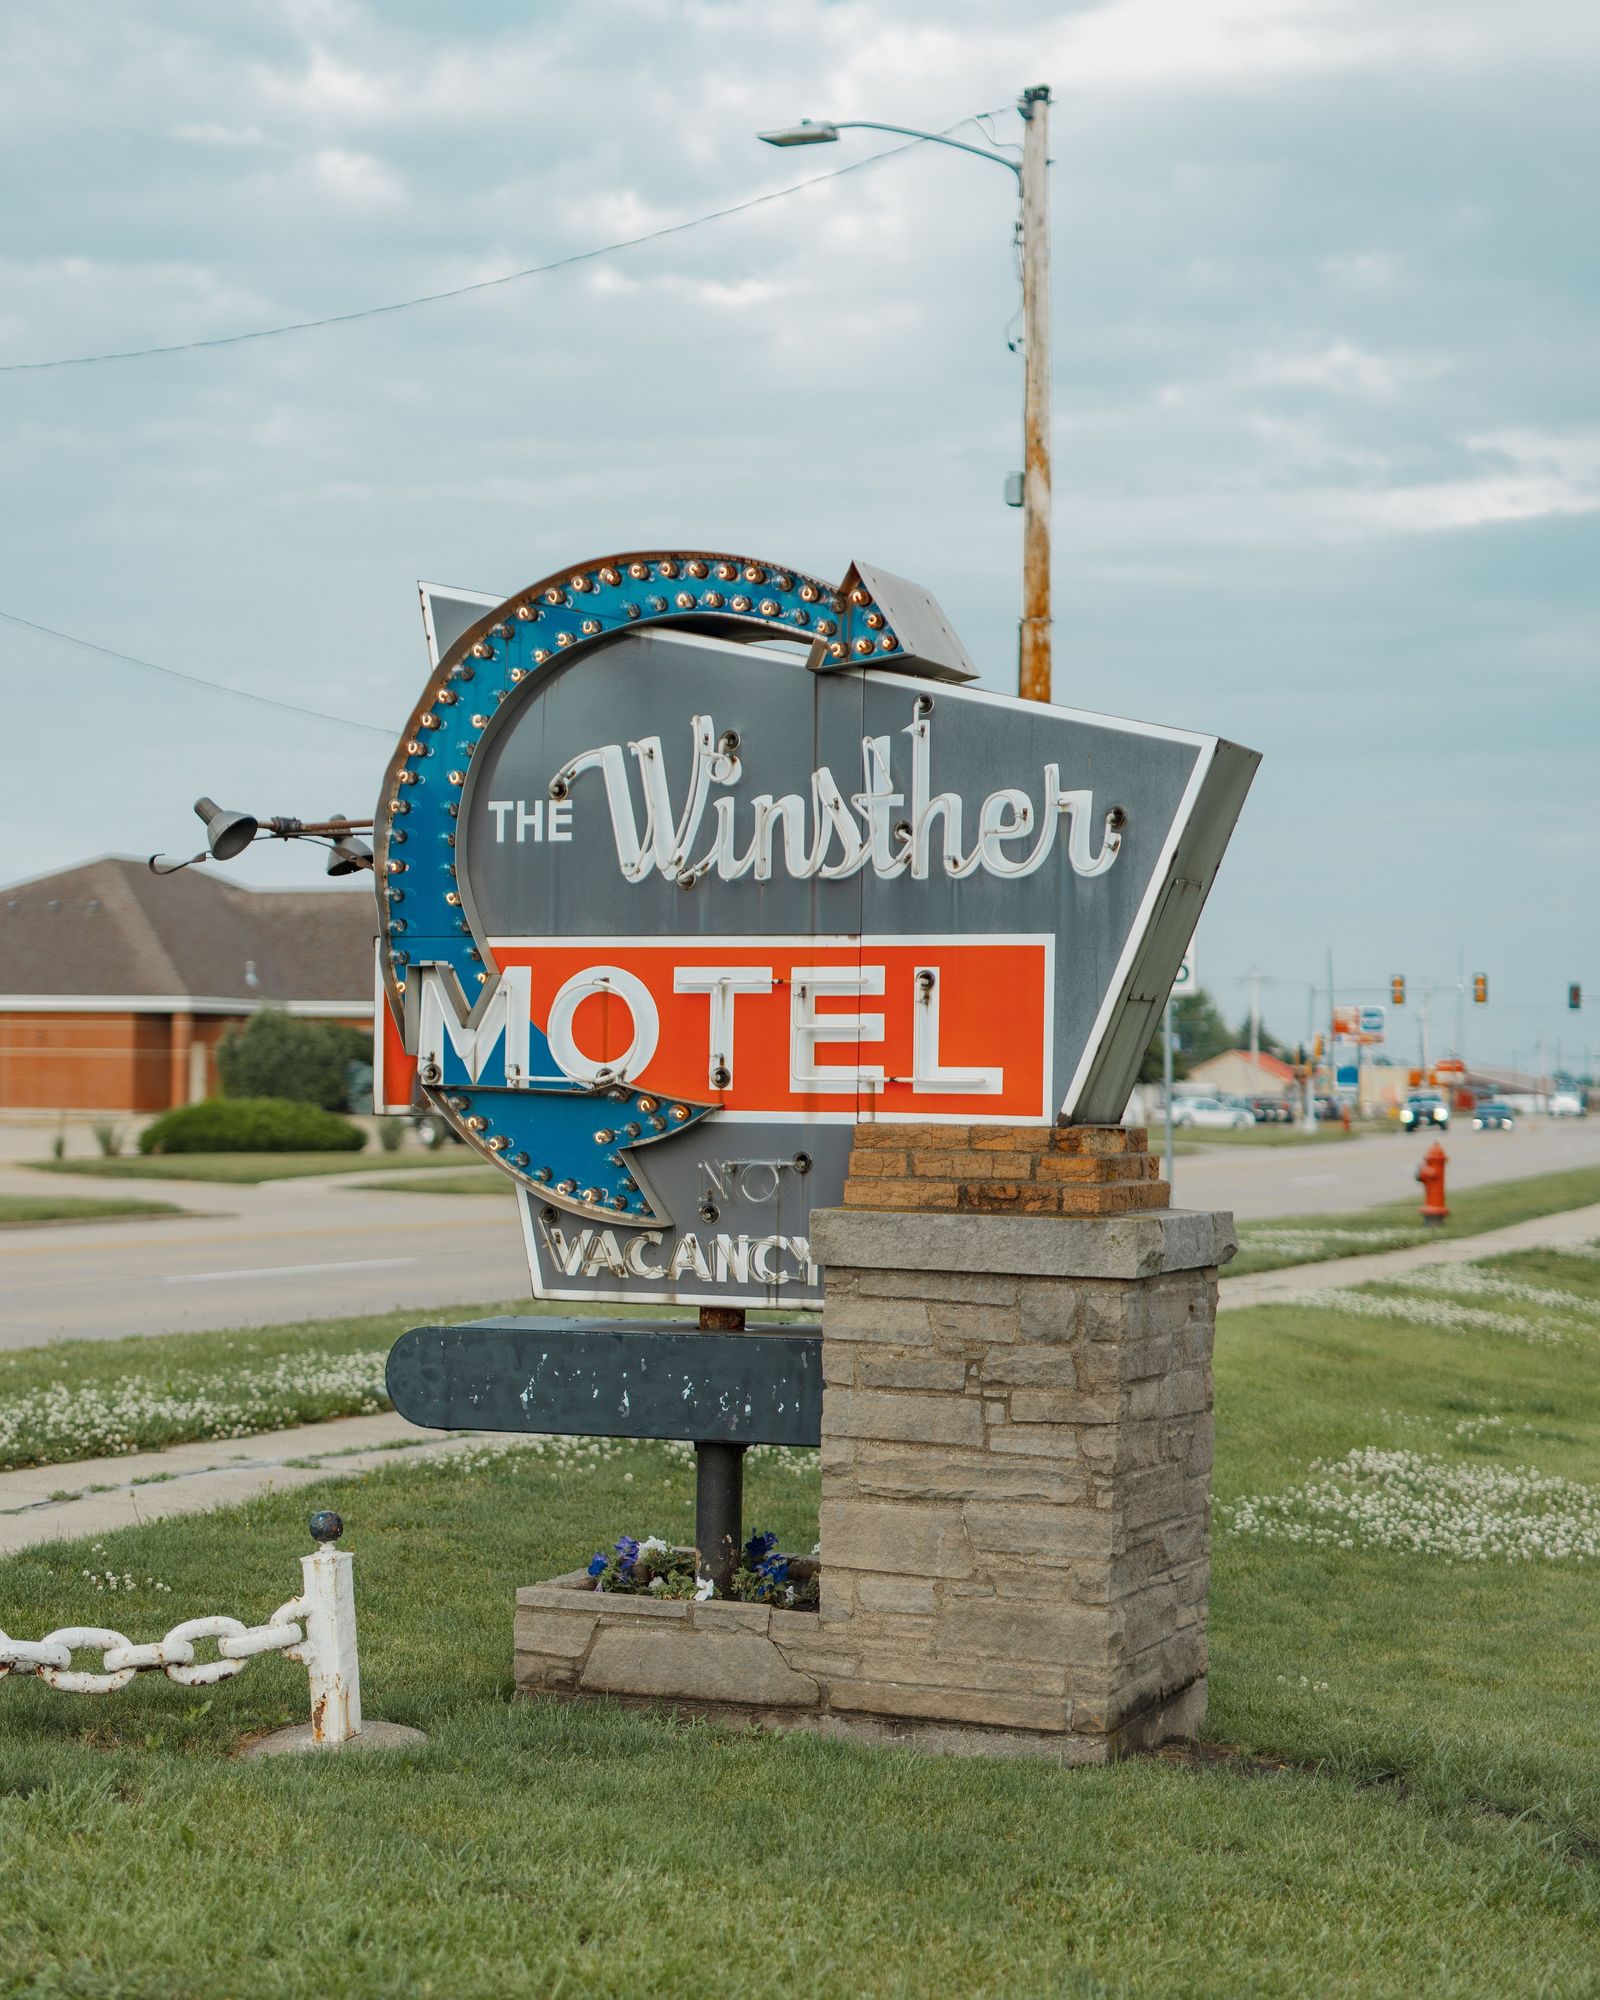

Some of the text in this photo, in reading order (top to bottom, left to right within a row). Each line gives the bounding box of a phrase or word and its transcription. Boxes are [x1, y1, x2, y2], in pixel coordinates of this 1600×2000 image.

[488, 714, 1122, 884] THE Winsther
[416, 962, 1004, 1095] MOTEL
[541, 1230, 819, 1287] VACANCY
